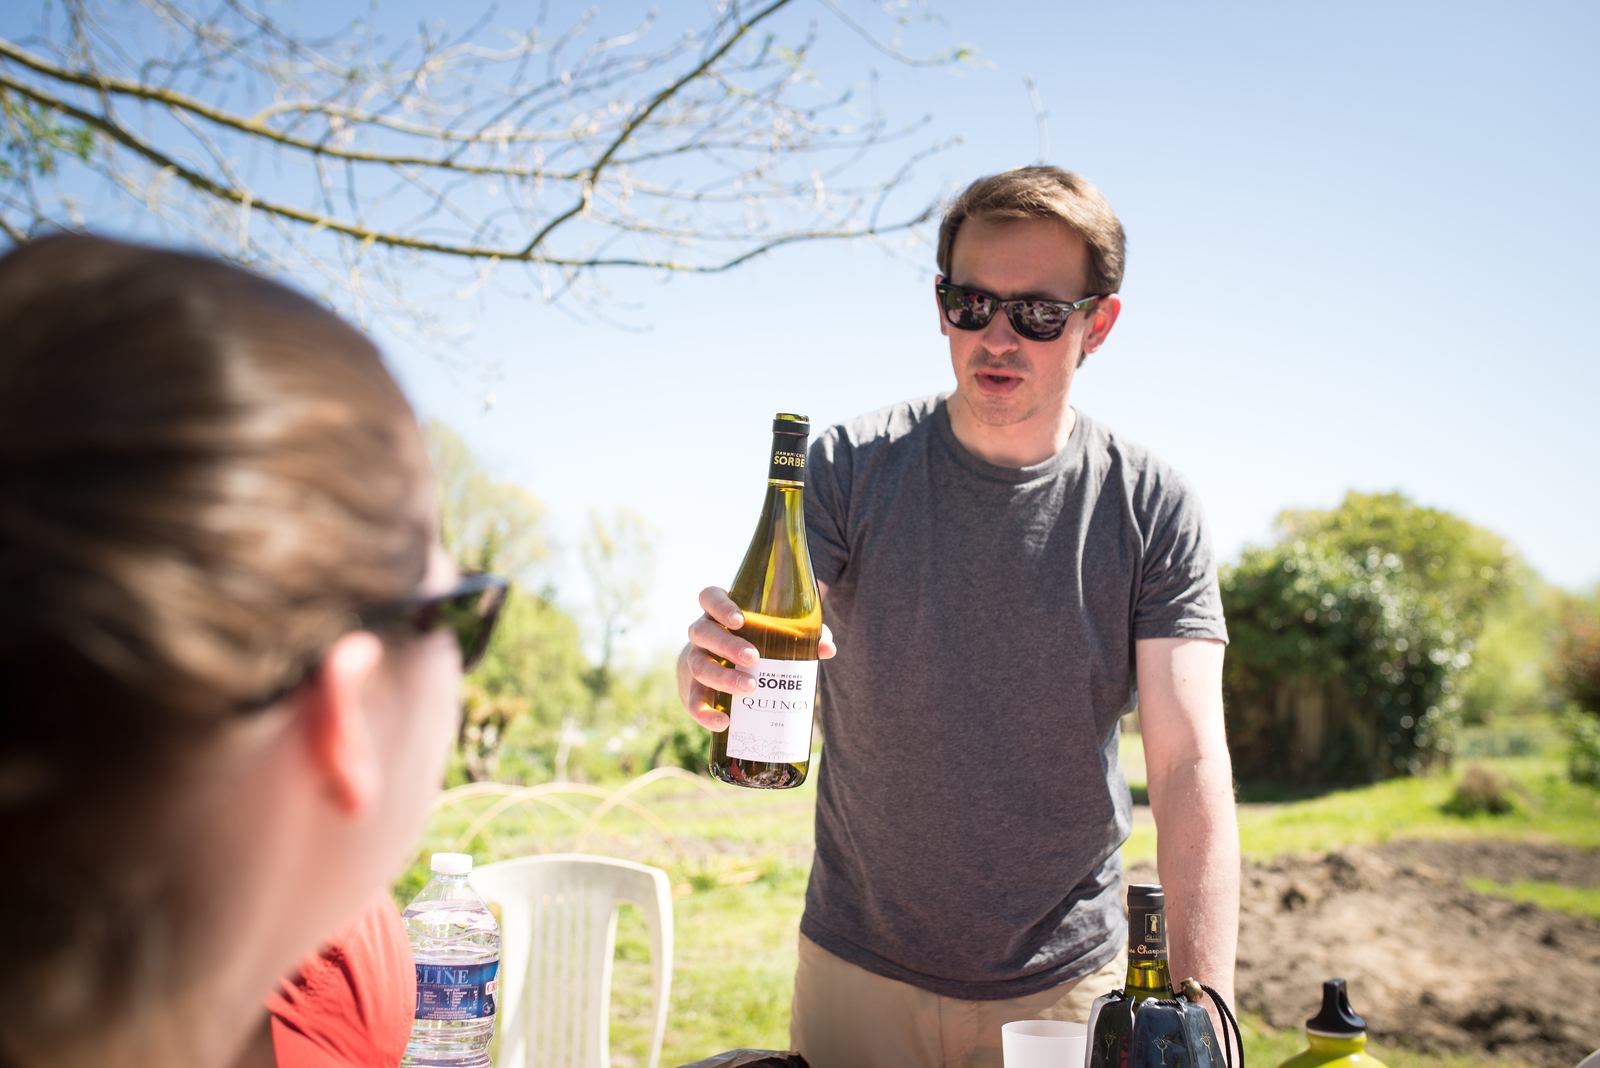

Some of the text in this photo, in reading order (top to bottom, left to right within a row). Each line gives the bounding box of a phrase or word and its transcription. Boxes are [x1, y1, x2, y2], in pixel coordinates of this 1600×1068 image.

[774, 456, 805, 467] SORBE
[758, 678, 802, 690] SORBE
[742, 697, 807, 709] QUINCY
